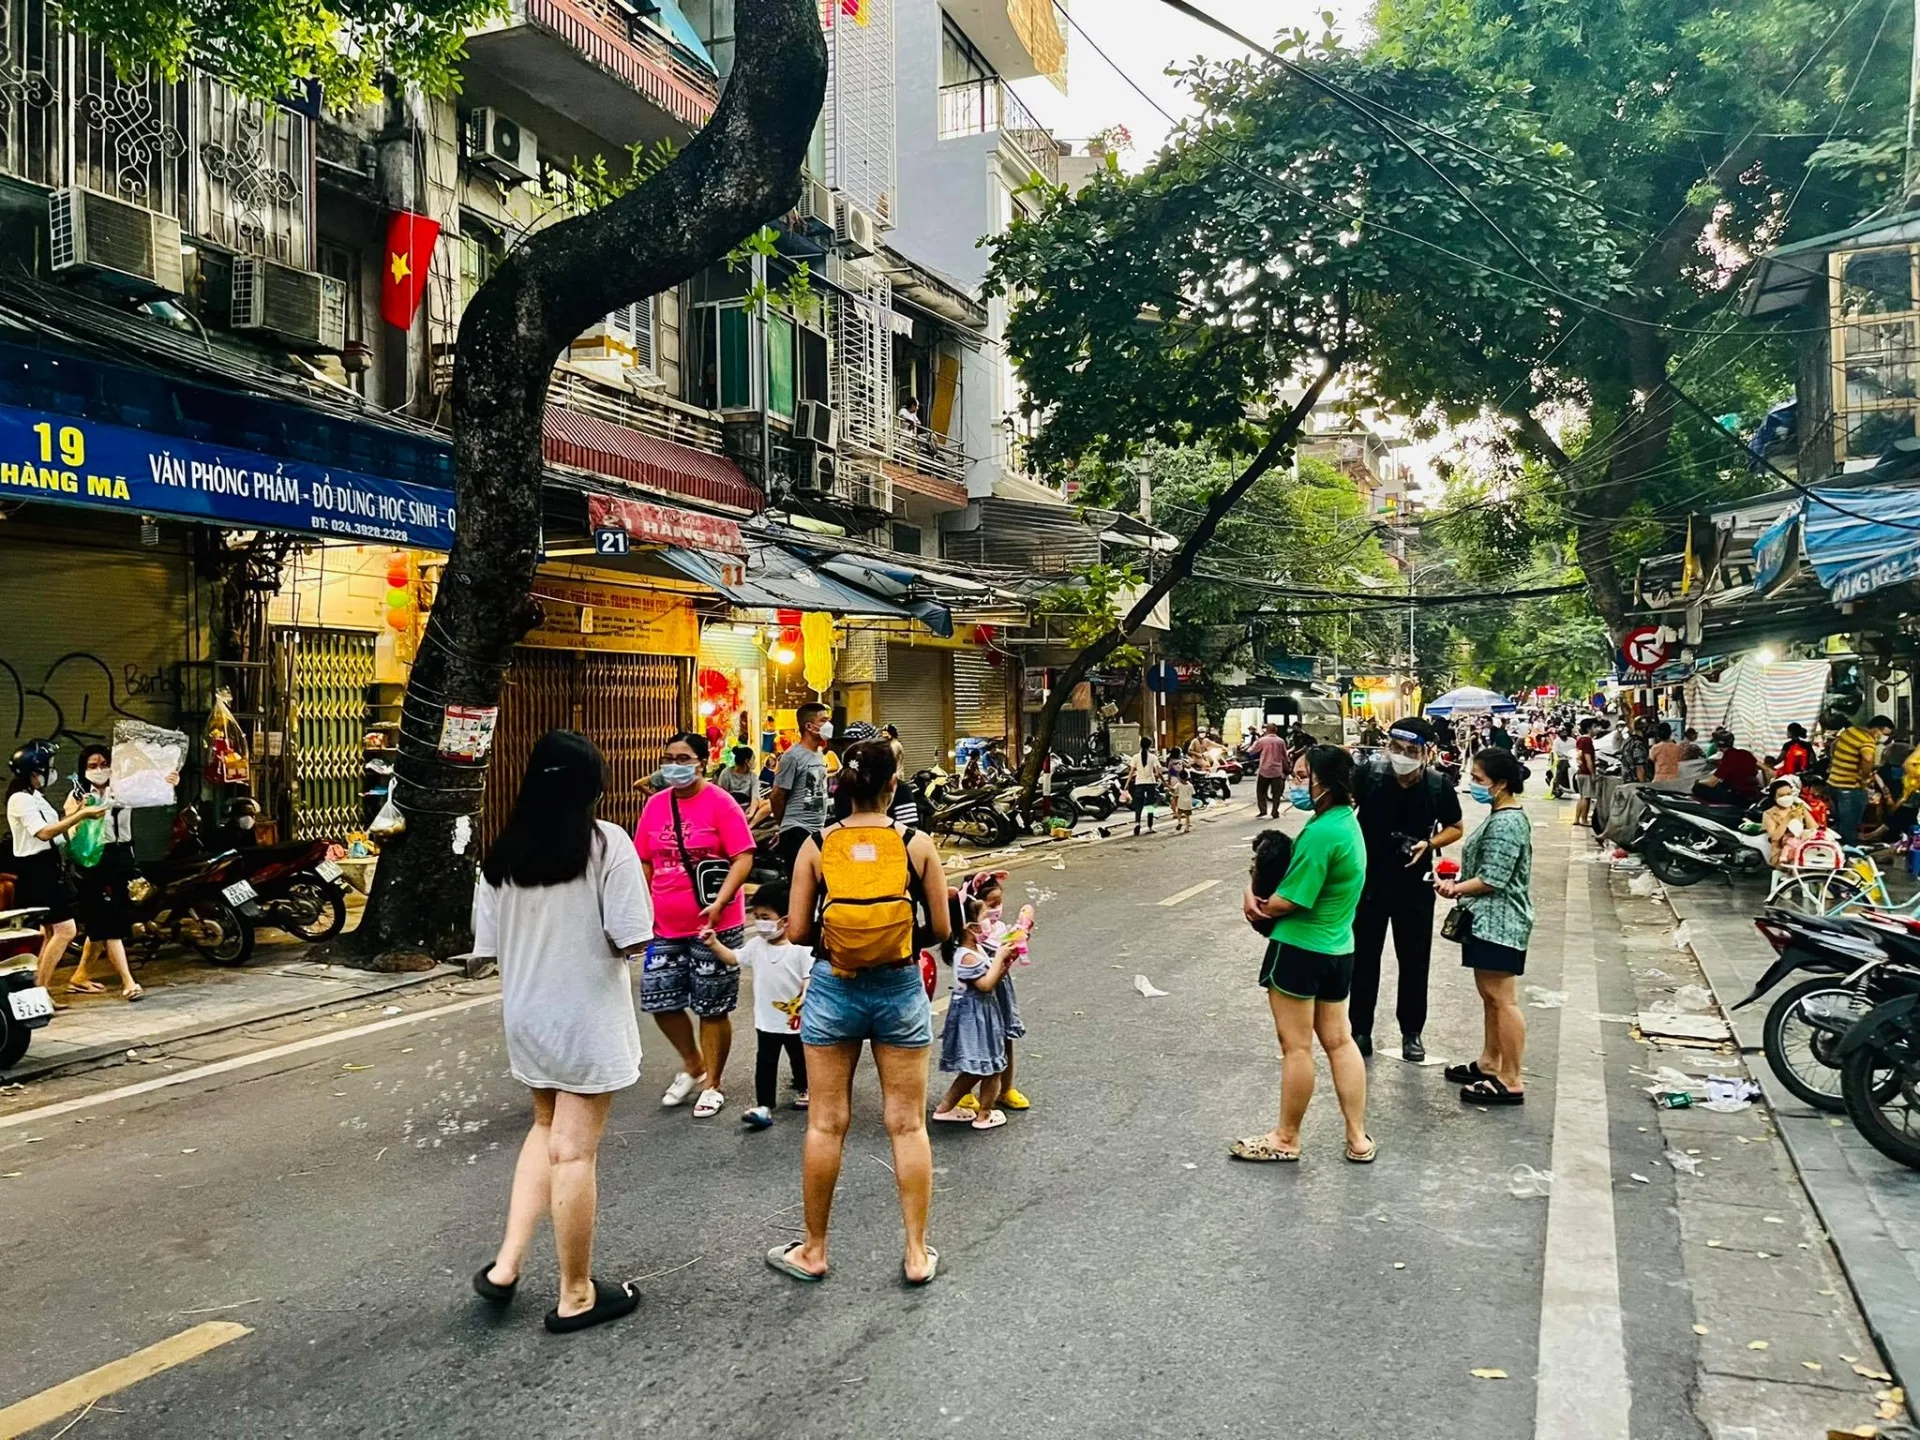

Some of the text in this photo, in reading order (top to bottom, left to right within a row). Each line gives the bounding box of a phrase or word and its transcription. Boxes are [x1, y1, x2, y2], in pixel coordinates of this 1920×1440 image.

[33, 422, 84, 467] 19
[1, 461, 131, 500] HÀNG MÃ
[148, 449, 187, 488] VĂN
[190, 456, 250, 498] PHÒNG
[253, 462, 300, 505] PHẨM
[337, 481, 376, 518] DÙNG
[379, 495, 407, 527] HỌC
[408, 501, 438, 528] SINH
[331, 519, 408, 542] 024.3928.2328
[601, 532, 625, 552] 21
[659, 831, 692, 842] CAM
[663, 822, 692, 833] KEP
